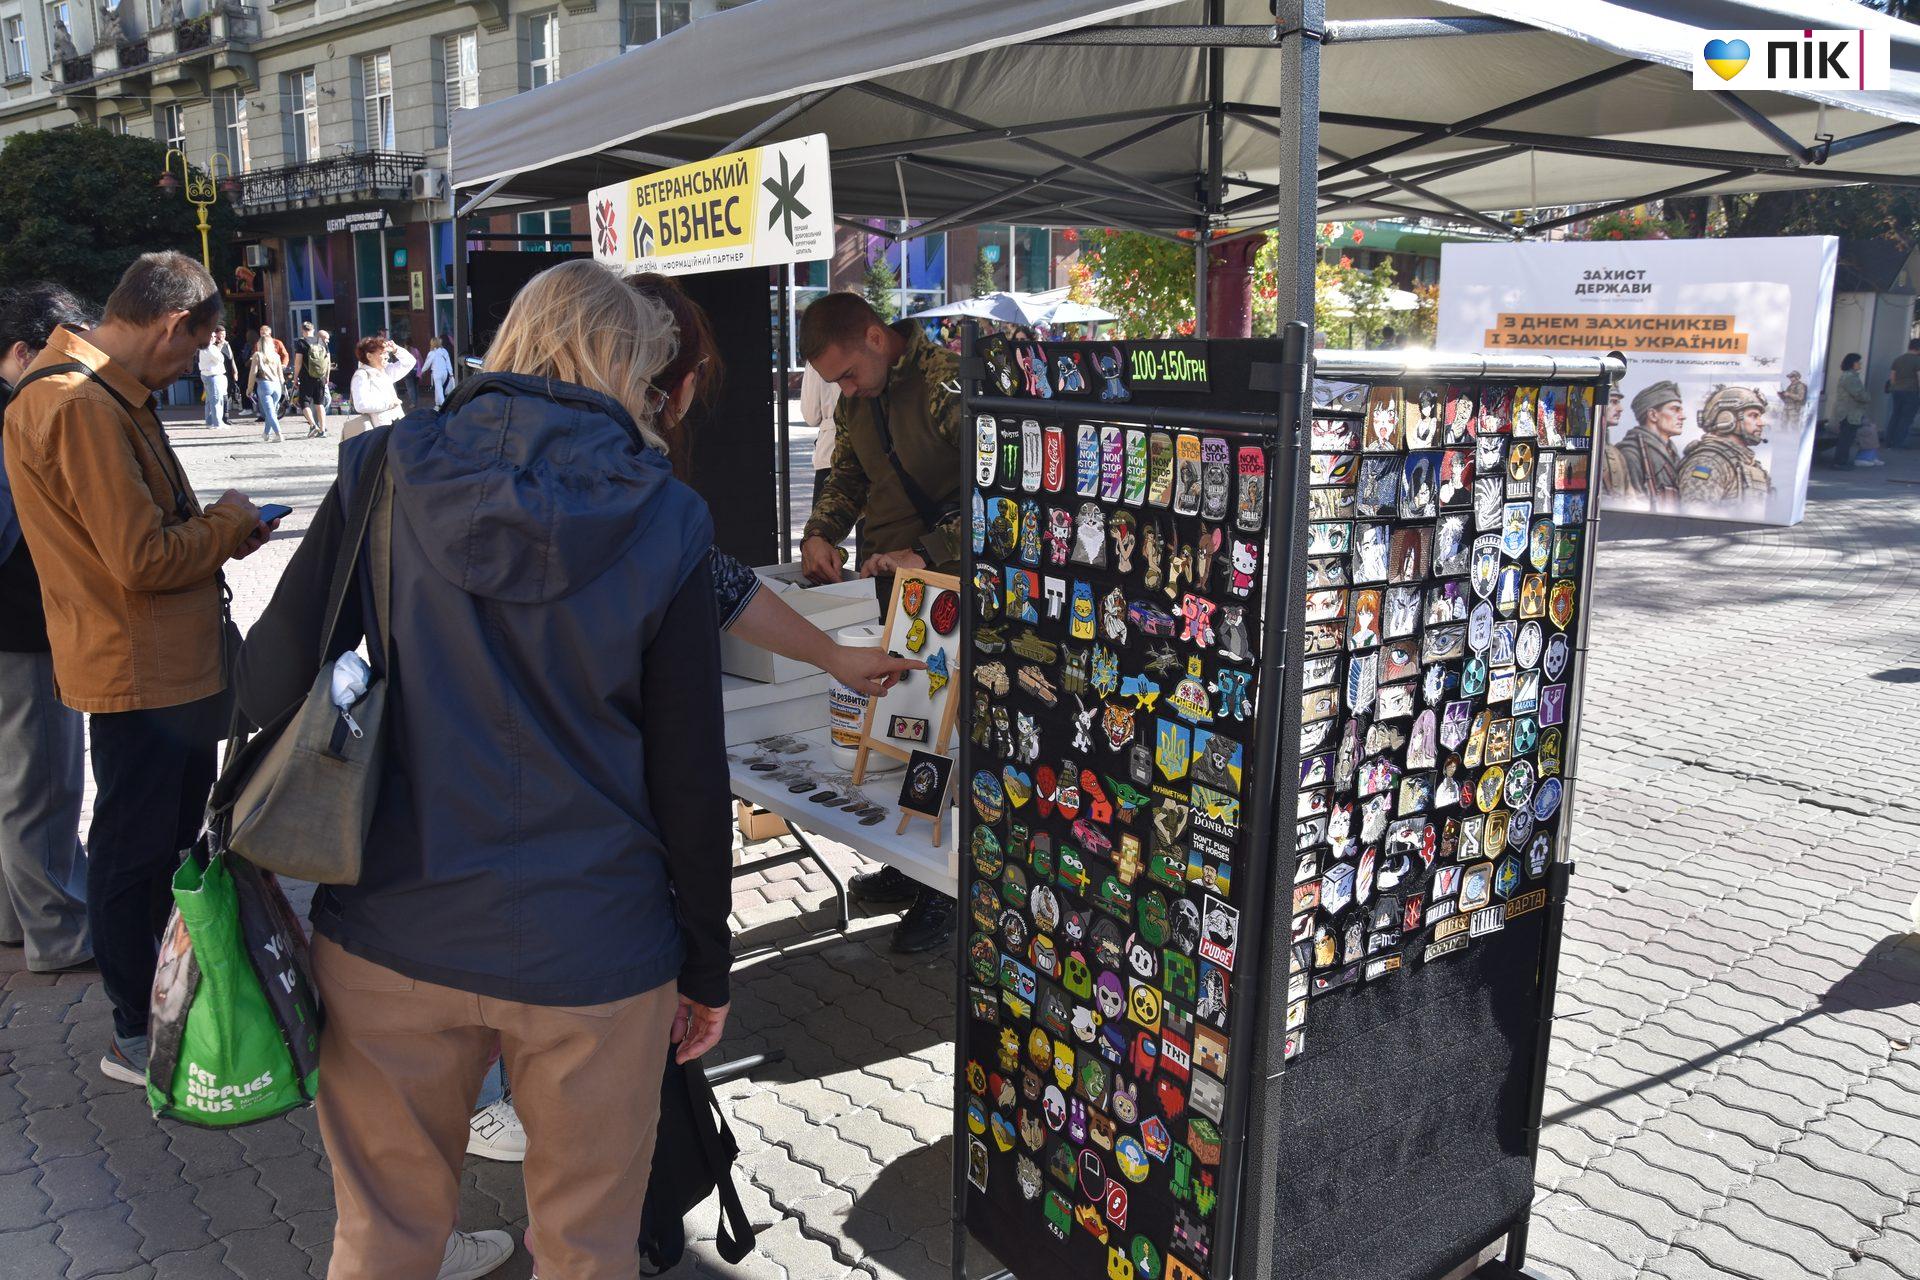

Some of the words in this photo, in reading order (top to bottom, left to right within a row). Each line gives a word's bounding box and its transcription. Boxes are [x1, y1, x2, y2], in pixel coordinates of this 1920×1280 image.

[637, 157, 749, 208] ВЕТЕРАНСЬКИЙ
[327, 218, 346, 233] ЦЕНТР
[659, 196, 743, 247] БІЗНЕС
[661, 254, 711, 270] ІНФОРМАЦІЙНИЙ
[712, 252, 744, 265] ПАРТНЕР
[1583, 269, 1646, 281] ЗАХИСТ
[1575, 283, 1652, 295] ДЕРЖАВИ
[1504, 317, 1516, 328] З
[1521, 317, 1579, 329] ДНЕМ
[1586, 318, 1728, 331] ЗАХИСНИКІВ
[1491, 333, 1499, 344] І
[1506, 334, 1628, 347] ЗАХИСНИЦЬ
[1635, 333, 1739, 350] УКРАЇНИ!
[1181, 441, 1199, 450] NON
[1205, 443, 1223, 453] NON
[1079, 450, 1097, 460] NON
[1103, 453, 1121, 463] NON
[1180, 450, 1200, 459] STOP
[1205, 453, 1227, 462] STOP
[1240, 454, 1258, 463] NON
[1078, 460, 1098, 468] STOP
[1128, 456, 1144, 466] NON
[1152, 457, 1170, 465] NON
[1101, 463, 1122, 472] STOP
[1126, 466, 1146, 475] STOP
[1152, 467, 1171, 477] STOP
[1240, 464, 1260, 473] STOP
[1475, 536, 1501, 548] STALKER
[1168, 694, 1213, 719] ДОНЕЦЬКА
[1194, 815, 1234, 838] DONBAS
[1193, 833, 1212, 846] DON'T
[1213, 841, 1230, 854] PUSH
[1193, 841, 1205, 851] THE
[1205, 846, 1230, 862] HORSES
[1202, 941, 1232, 966] PUDGE
[1165, 1042, 1187, 1065] TNT
[189, 1062, 217, 1087] PET
[188, 1070, 273, 1100] SUPPLIES
[186, 1094, 234, 1113] PLUS
[1047, 1222, 1064, 1240] 4.5.0
